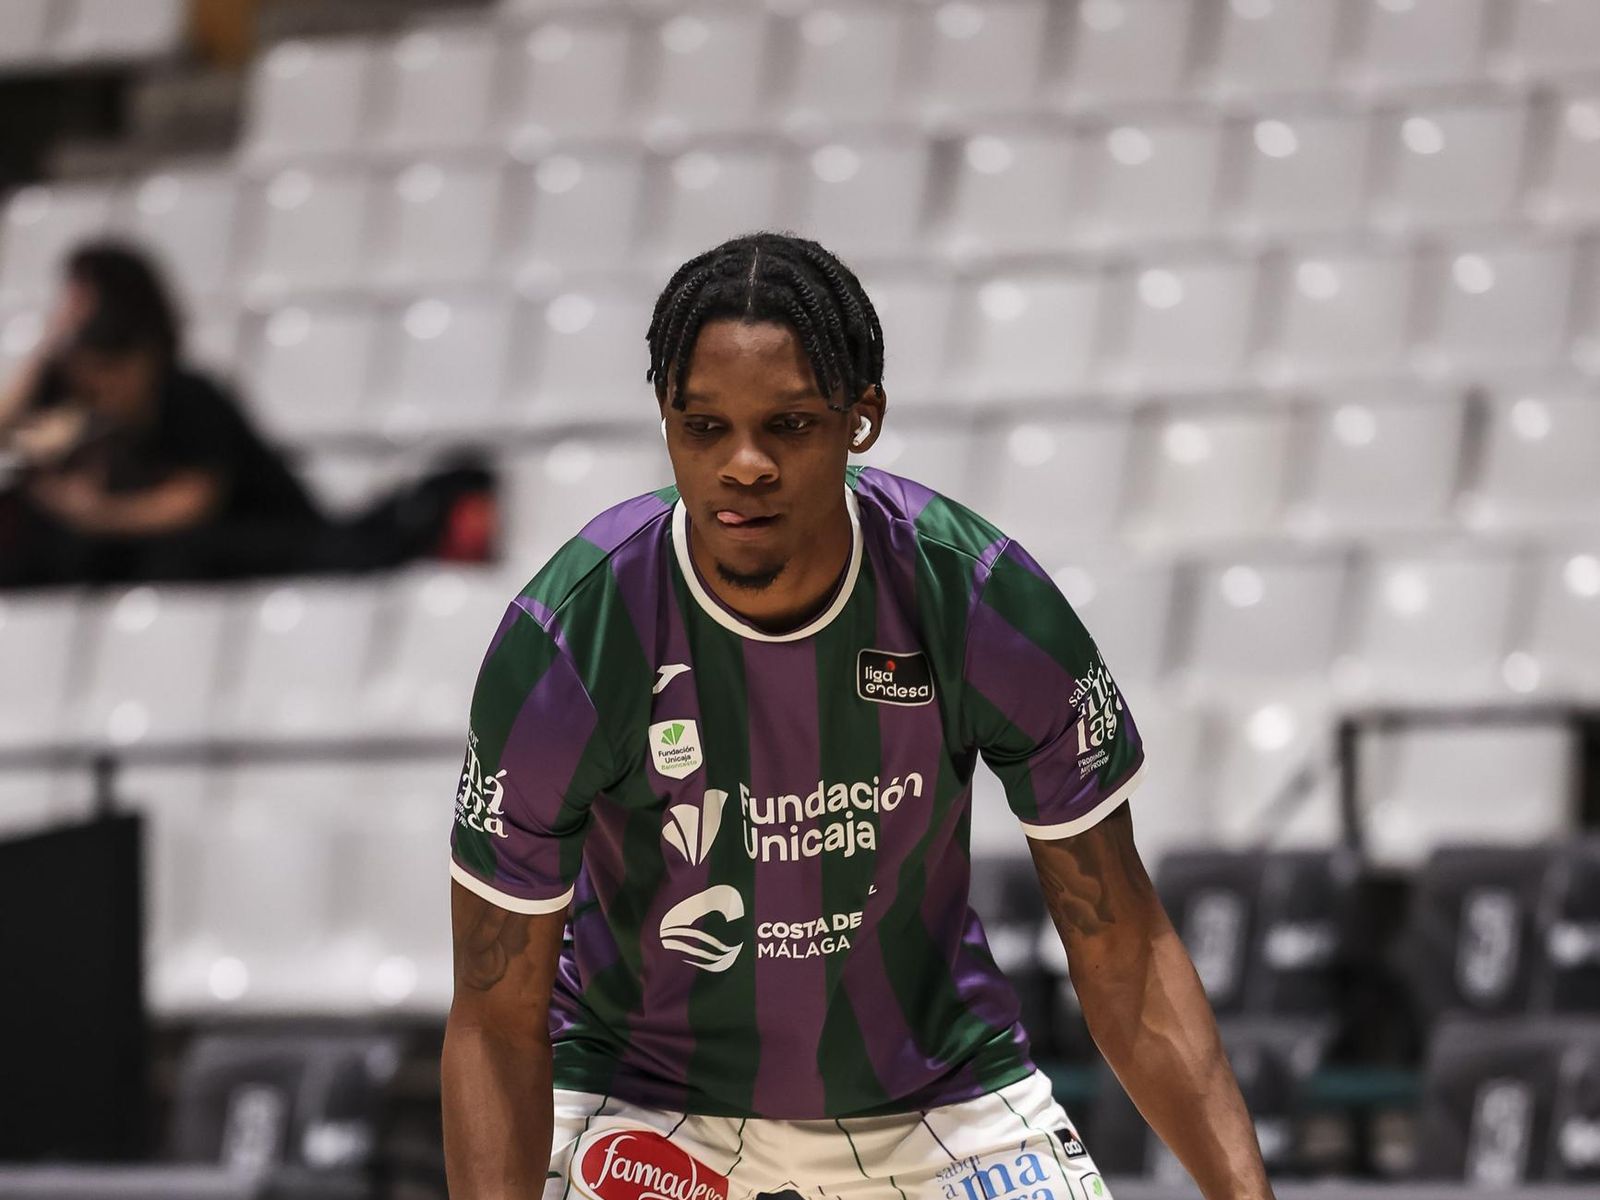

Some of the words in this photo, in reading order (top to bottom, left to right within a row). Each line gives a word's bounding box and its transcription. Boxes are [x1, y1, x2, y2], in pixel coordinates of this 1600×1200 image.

[865, 665, 893, 683] liga
[865, 683, 929, 698] endesa
[658, 746, 695, 757] Fundación
[664, 754, 692, 764] Unicaja
[739, 772, 923, 825] Fundación
[743, 811, 876, 862] Unicaja
[757, 917, 830, 939] COSTA
[832, 911, 863, 932] DE
[757, 934, 851, 959] MÁLAGA
[941, 1183, 959, 1200] a
